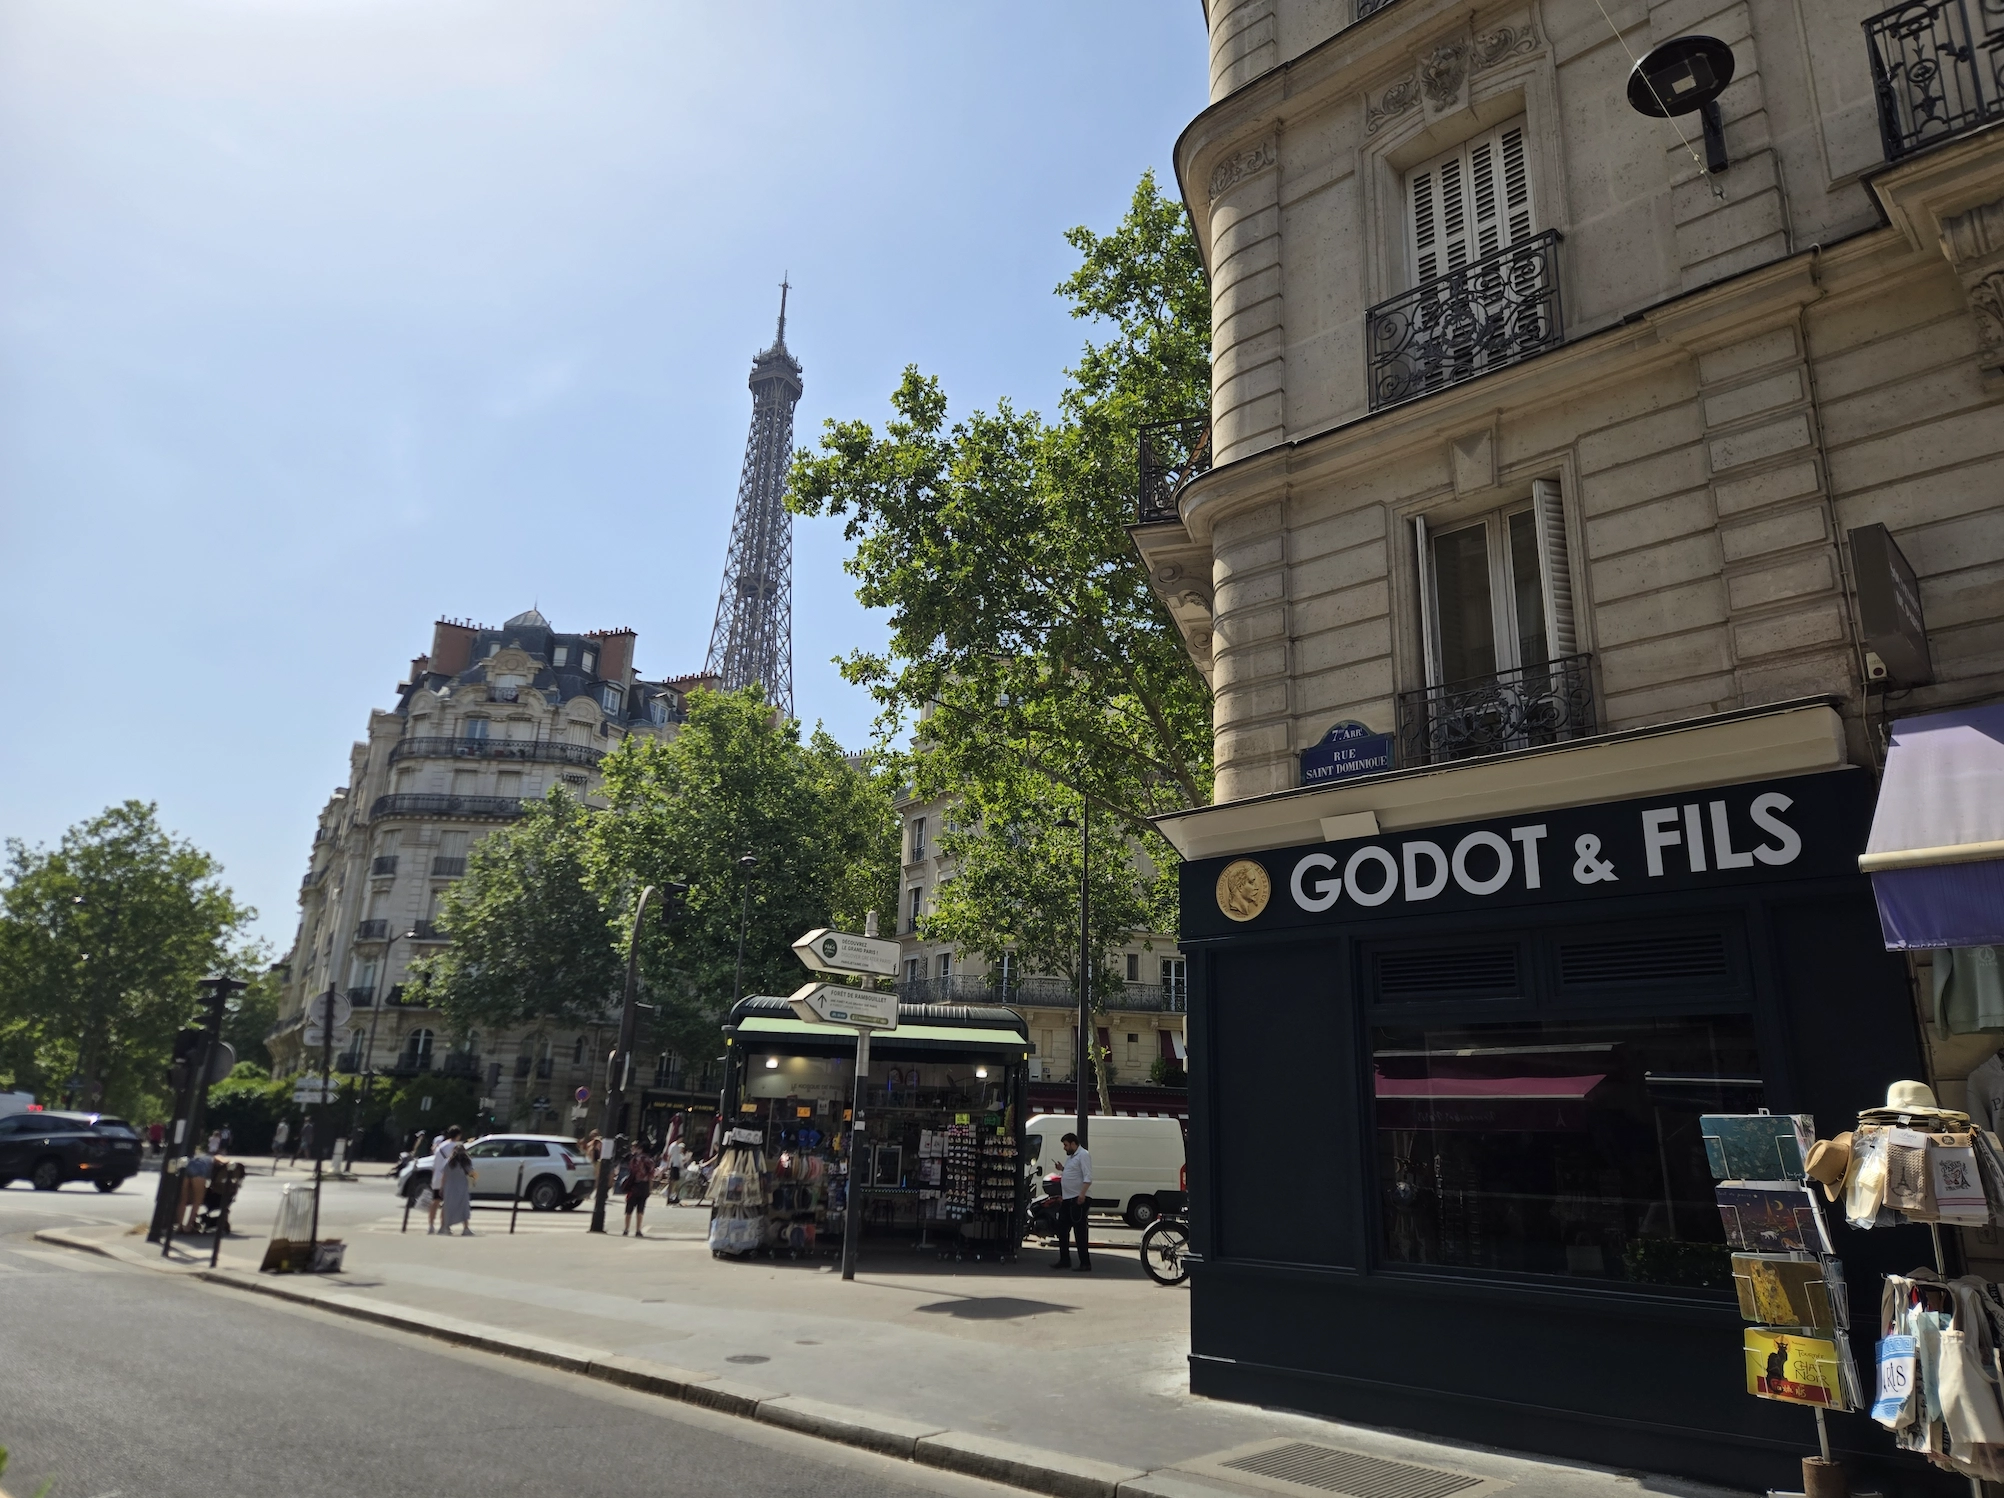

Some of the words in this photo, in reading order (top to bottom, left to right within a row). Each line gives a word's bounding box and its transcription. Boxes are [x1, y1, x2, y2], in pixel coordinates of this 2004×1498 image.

[1333, 748, 1356, 762] RUE
[1306, 765, 1334, 780] SAINT
[1336, 755, 1388, 774] DOMINIQUE
[1290, 824, 1548, 913] GODOT
[1572, 833, 1620, 885] &
[1642, 793, 1802, 877] FILS
[842, 939, 868, 948] DÉCOUVREZ
[830, 989, 847, 997] FORÊT
[855, 993, 887, 1003] RAMBOUILLET
[1991, 1097, 2004, 1112] P
[1793, 1360, 1824, 1375] CHAT
[1795, 1369, 1830, 1387] NOIR
